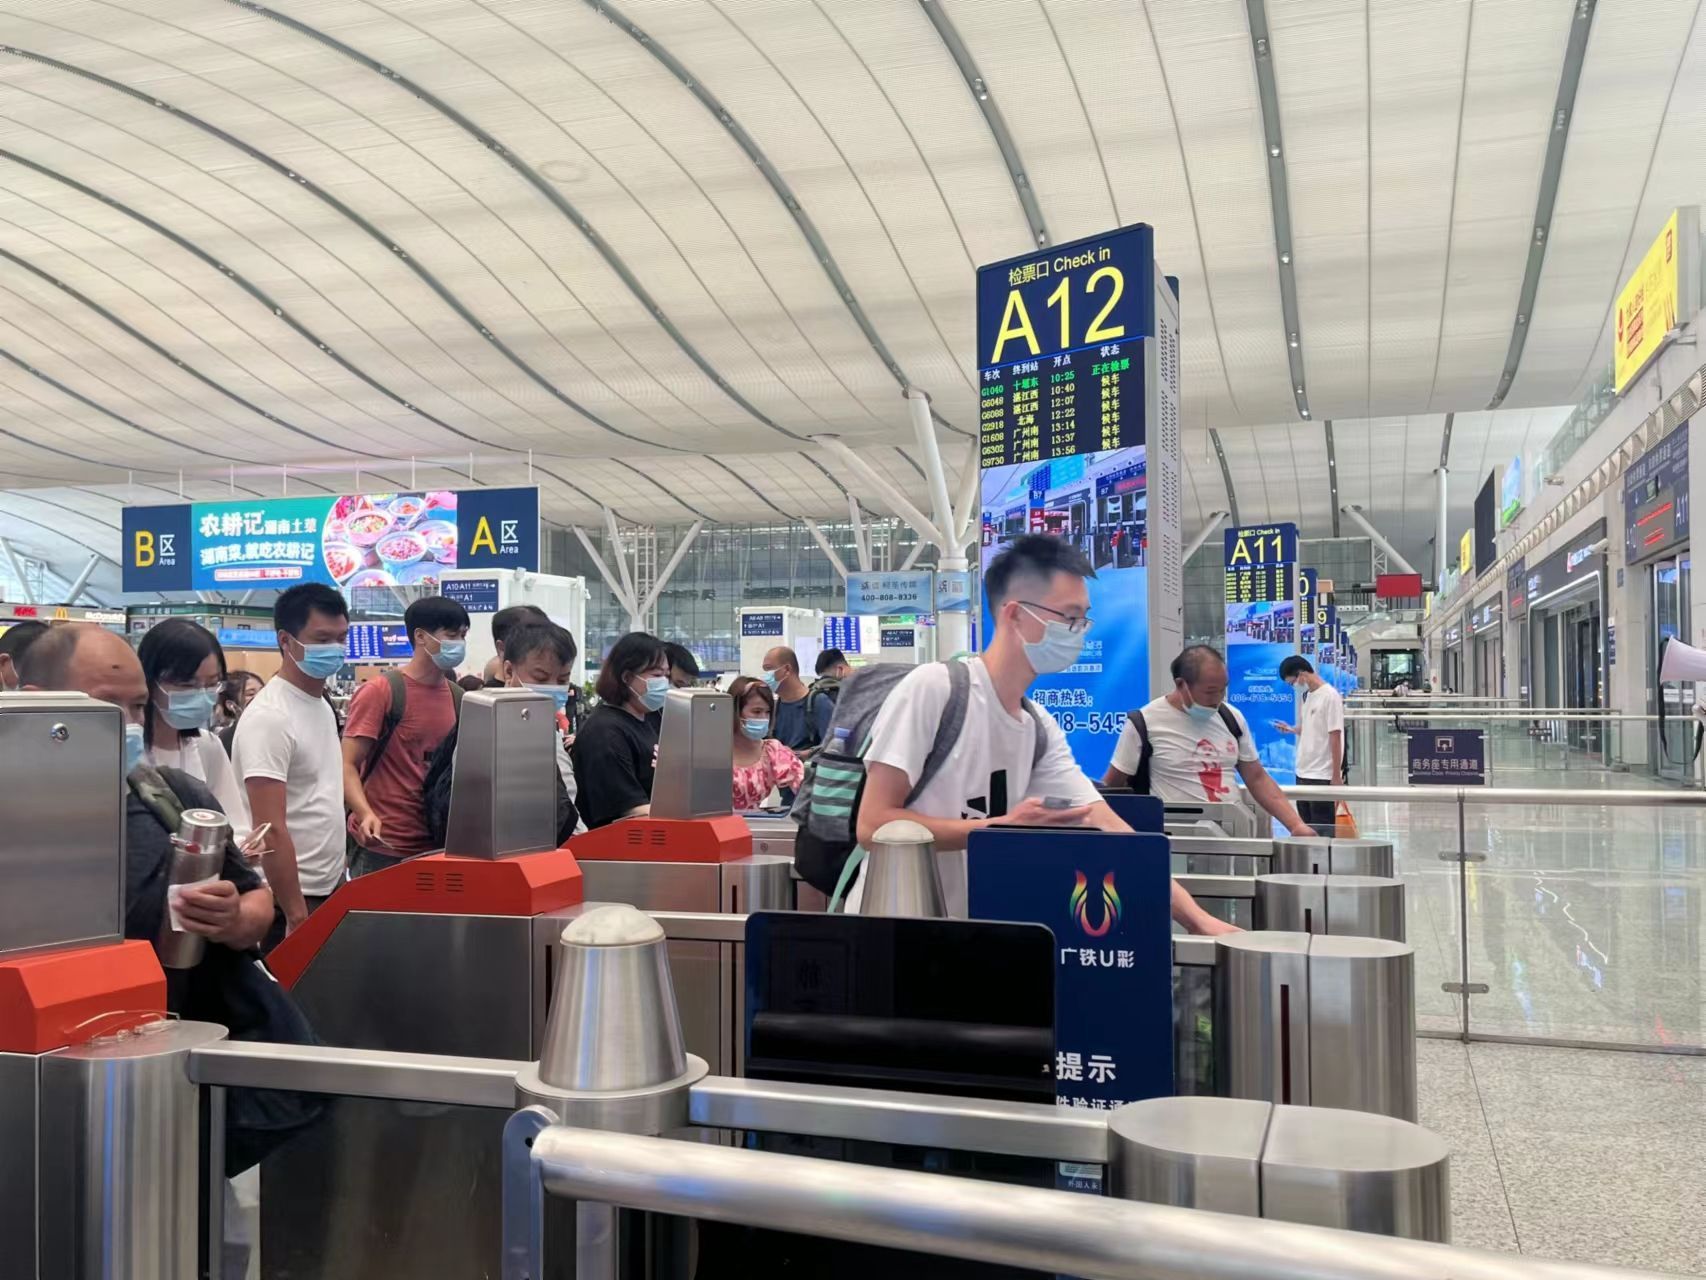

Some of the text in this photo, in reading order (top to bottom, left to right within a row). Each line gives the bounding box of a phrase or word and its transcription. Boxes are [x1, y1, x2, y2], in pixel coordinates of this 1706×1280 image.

[1008, 247, 1111, 287] 检票口 Check in
[991, 266, 1125, 364] A12
[984, 344, 1120, 381] 车次 终到站 开点 状态
[1051, 371, 1075, 383] 10:25
[1051, 383, 1075, 395] 10:40
[1051, 395, 1075, 408] 12:07
[1051, 408, 1075, 420] 12:22
[1013, 425, 1039, 439] 广州南
[1051, 420, 1075, 432] 13:14
[1013, 438, 1039, 451] 广州南
[1051, 432, 1075, 444] 13:37
[1013, 450, 1039, 463] 广州南
[1051, 445, 1075, 457] 13:56
[199, 510, 264, 537] 农耕记
[469, 516, 519, 555] A 区
[135, 530, 176, 567] B 区
[500, 545, 519, 554] Area
[1230, 535, 1282, 565] A11
[159, 557, 176, 566] Area
[1412, 758, 1478, 770] 商务座专用通道
[1061, 947, 1135, 968] 广铁U彩
[1056, 1051, 1116, 1083] 提示
